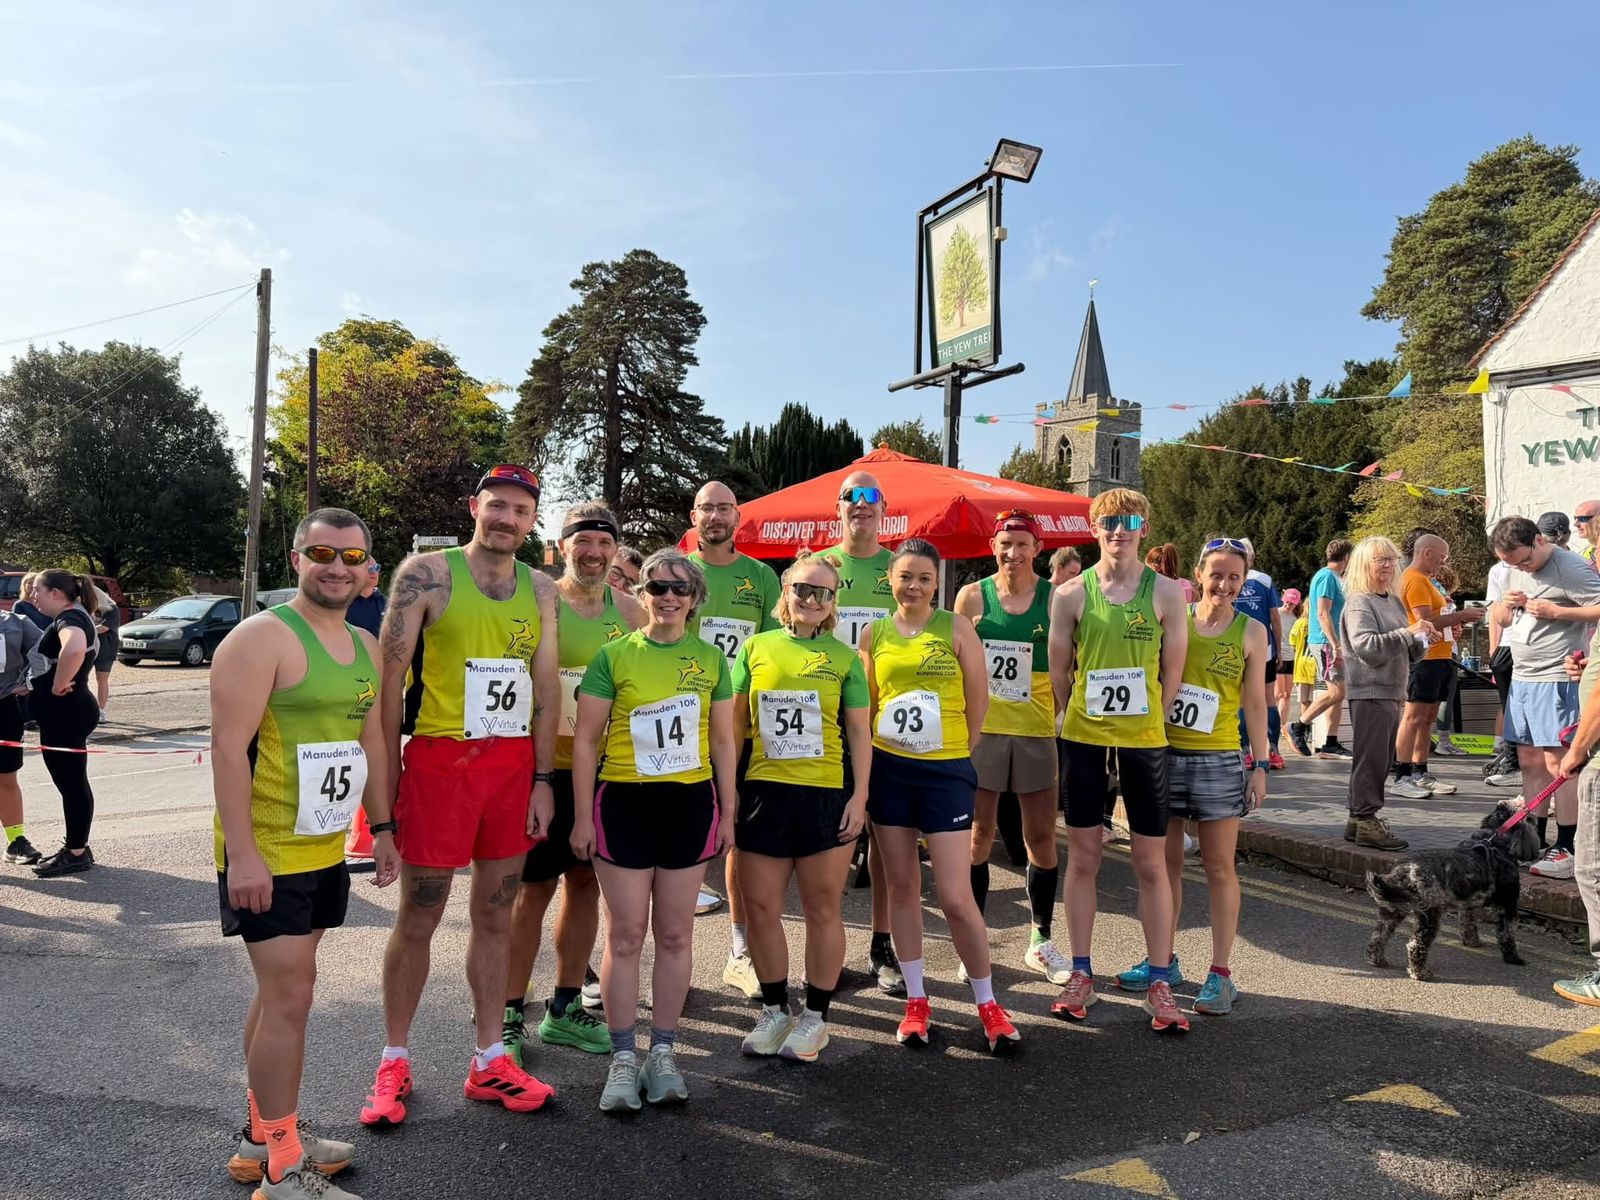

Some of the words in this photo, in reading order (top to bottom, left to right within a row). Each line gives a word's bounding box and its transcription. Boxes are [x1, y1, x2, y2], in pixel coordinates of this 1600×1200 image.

[937, 347, 953, 360] THE
[953, 340, 972, 355] YEW
[1521, 436, 1600, 465] YEW
[762, 521, 815, 539] DISCOVER
[817, 520, 829, 531] THE
[828, 520, 844, 539] SO
[877, 515, 908, 536] ADRID
[1061, 516, 1091, 532] MADRID
[702, 620, 736, 630] Manuden
[713, 633, 737, 658] 52
[986, 642, 1016, 653] anuden
[469, 664, 515, 674] Manuden
[518, 665, 526, 674] 10
[560, 669, 585, 679] Manu
[992, 655, 1018, 681] 28
[1089, 673, 1125, 682] Manuden
[485, 680, 517, 712] 56
[1102, 685, 1131, 713] 29
[1201, 692, 1217, 704] 10K
[633, 702, 677, 717] Manuden
[679, 696, 697, 709] 10K
[1169, 699, 1199, 727] 30
[497, 719, 518, 730] Virtus
[774, 708, 805, 736] 54
[893, 705, 924, 734] 93
[655, 715, 685, 749] 14
[302, 749, 349, 760] Manuden
[786, 742, 812, 752] Virtus
[667, 752, 692, 765] Virtus
[320, 765, 352, 803] 45
[332, 811, 352, 824] Virtus
